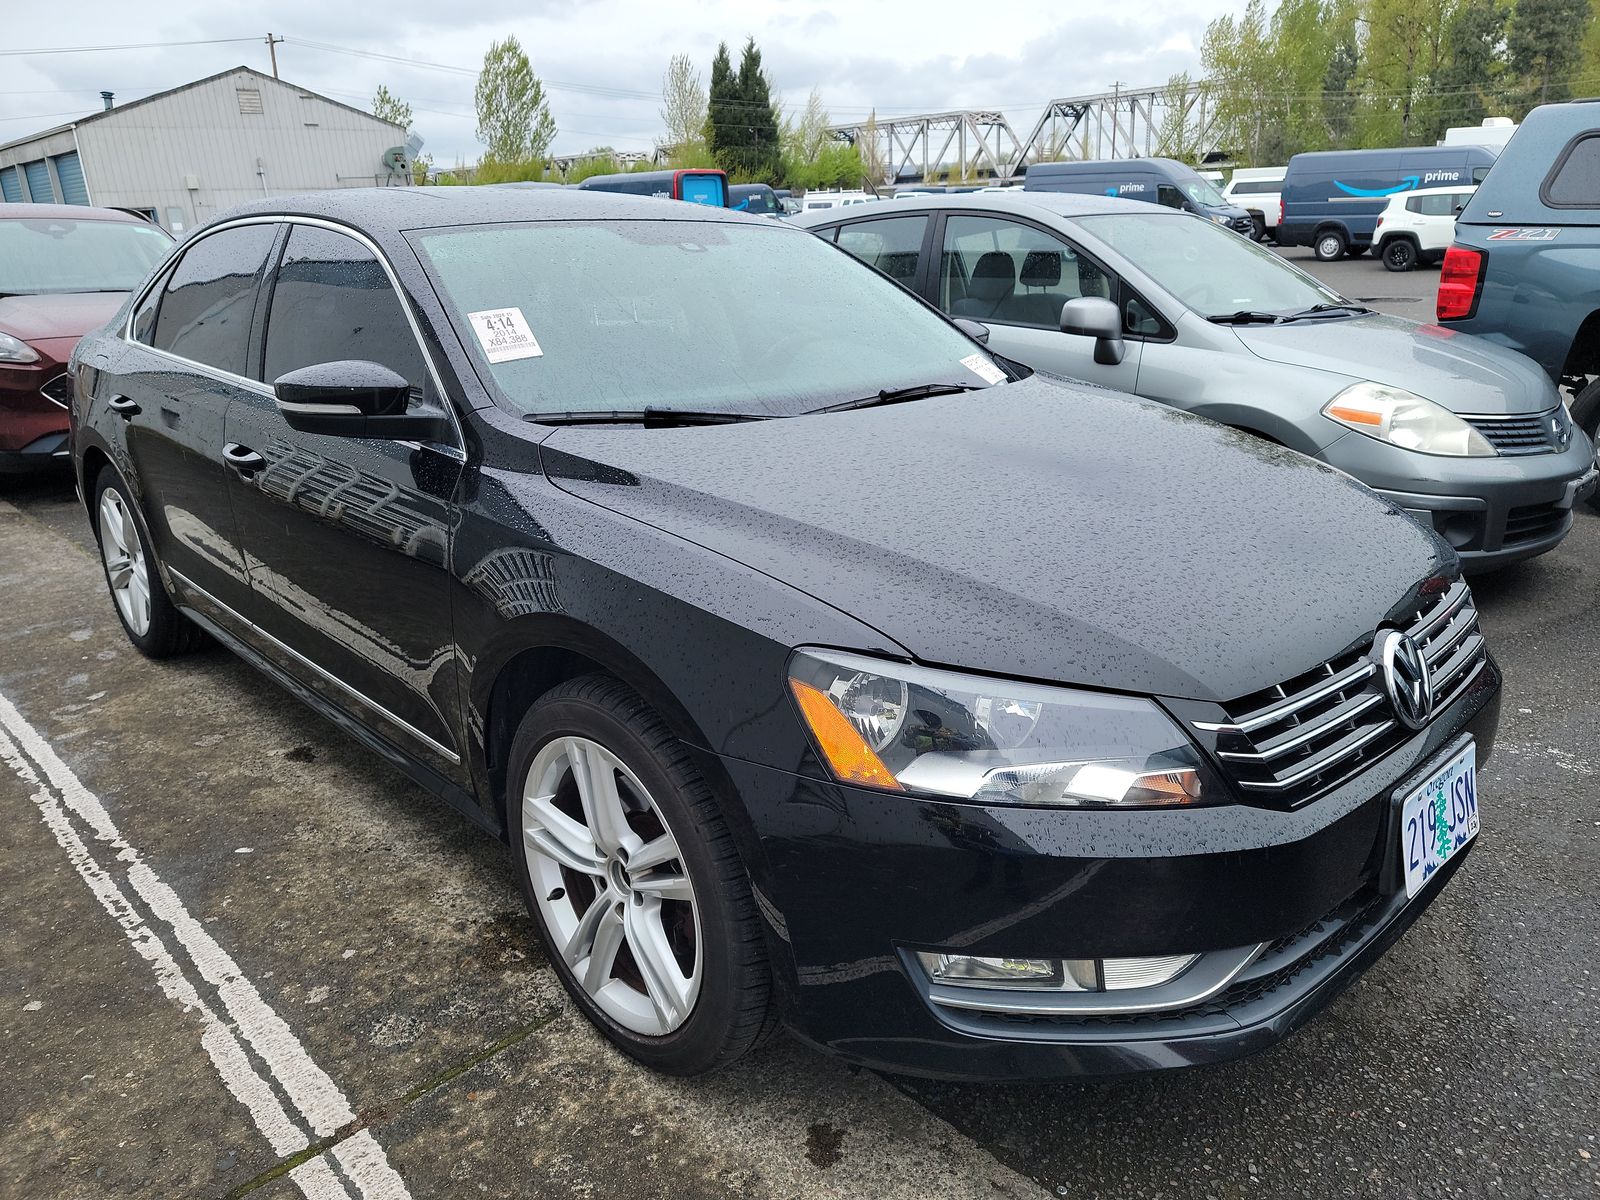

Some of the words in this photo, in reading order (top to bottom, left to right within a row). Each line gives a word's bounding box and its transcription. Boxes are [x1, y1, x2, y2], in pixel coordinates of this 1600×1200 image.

[1424, 169, 1460, 184] prime
[1119, 182, 1145, 194] prime
[1486, 228, 1562, 241] Z71
[487, 317, 514, 330] 4:14
[493, 329, 517, 337] 2014
[1407, 799, 1437, 872] 219
[1448, 766, 1476, 833] JSN
